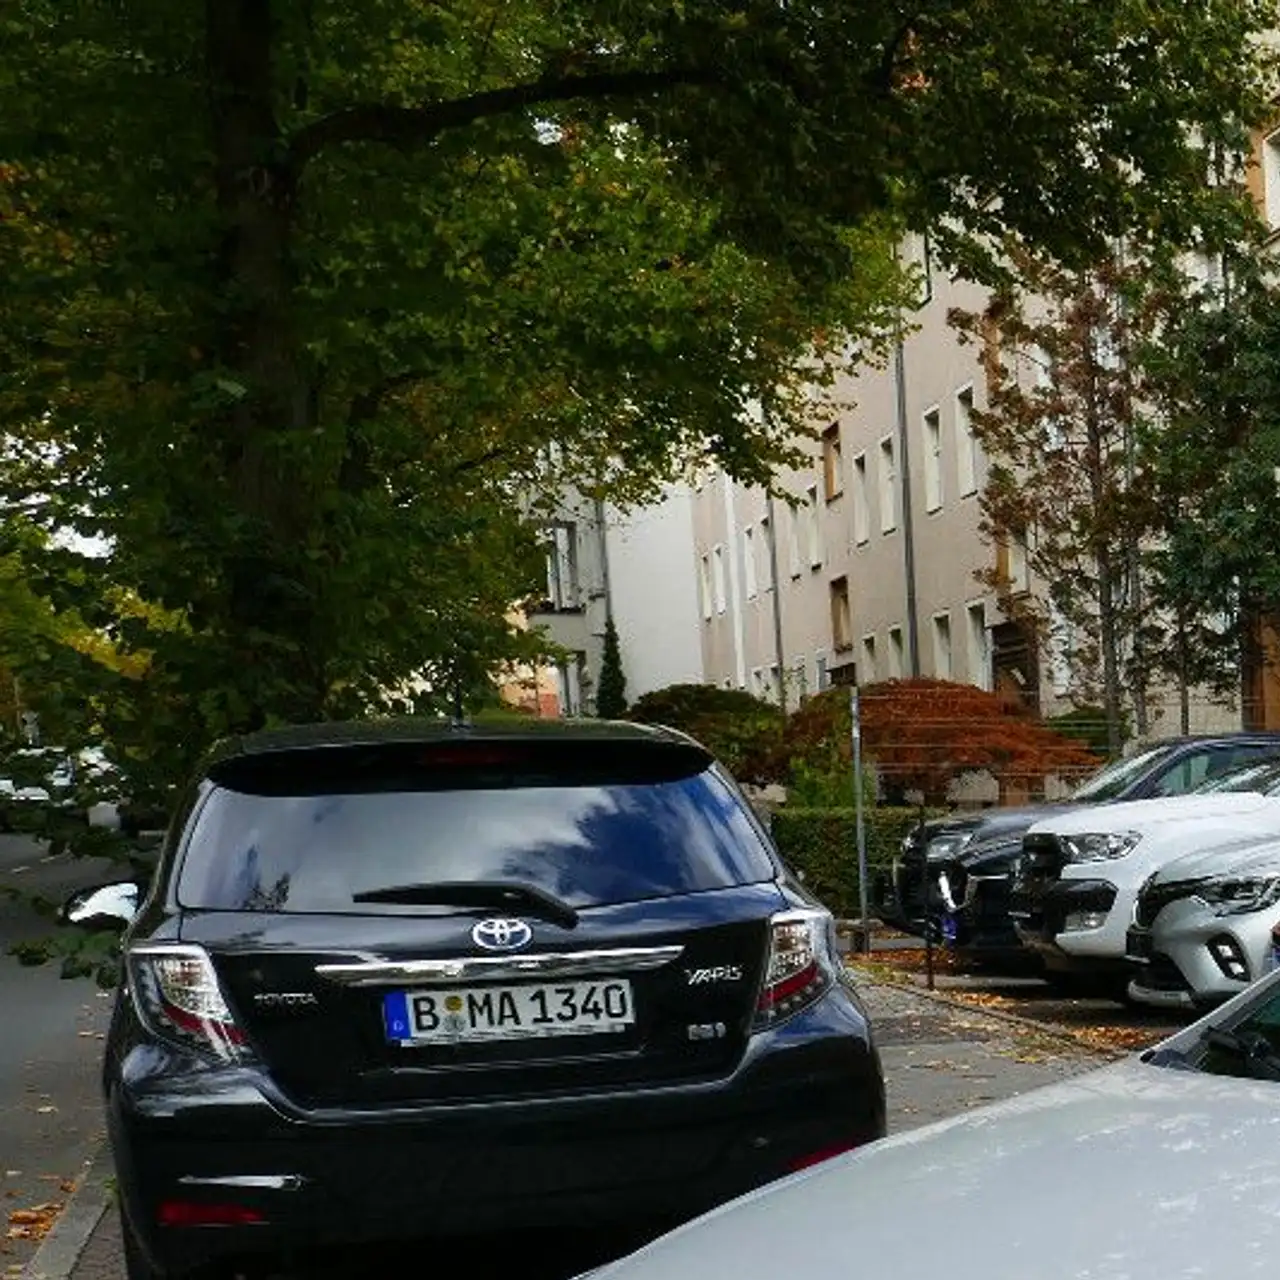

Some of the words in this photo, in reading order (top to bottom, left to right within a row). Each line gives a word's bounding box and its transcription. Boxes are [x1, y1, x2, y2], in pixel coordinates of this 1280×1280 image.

[684, 965, 743, 985] YARIS
[412, 997, 440, 1032] B
[467, 991, 522, 1028] MA
[529, 984, 628, 1024] 1340
